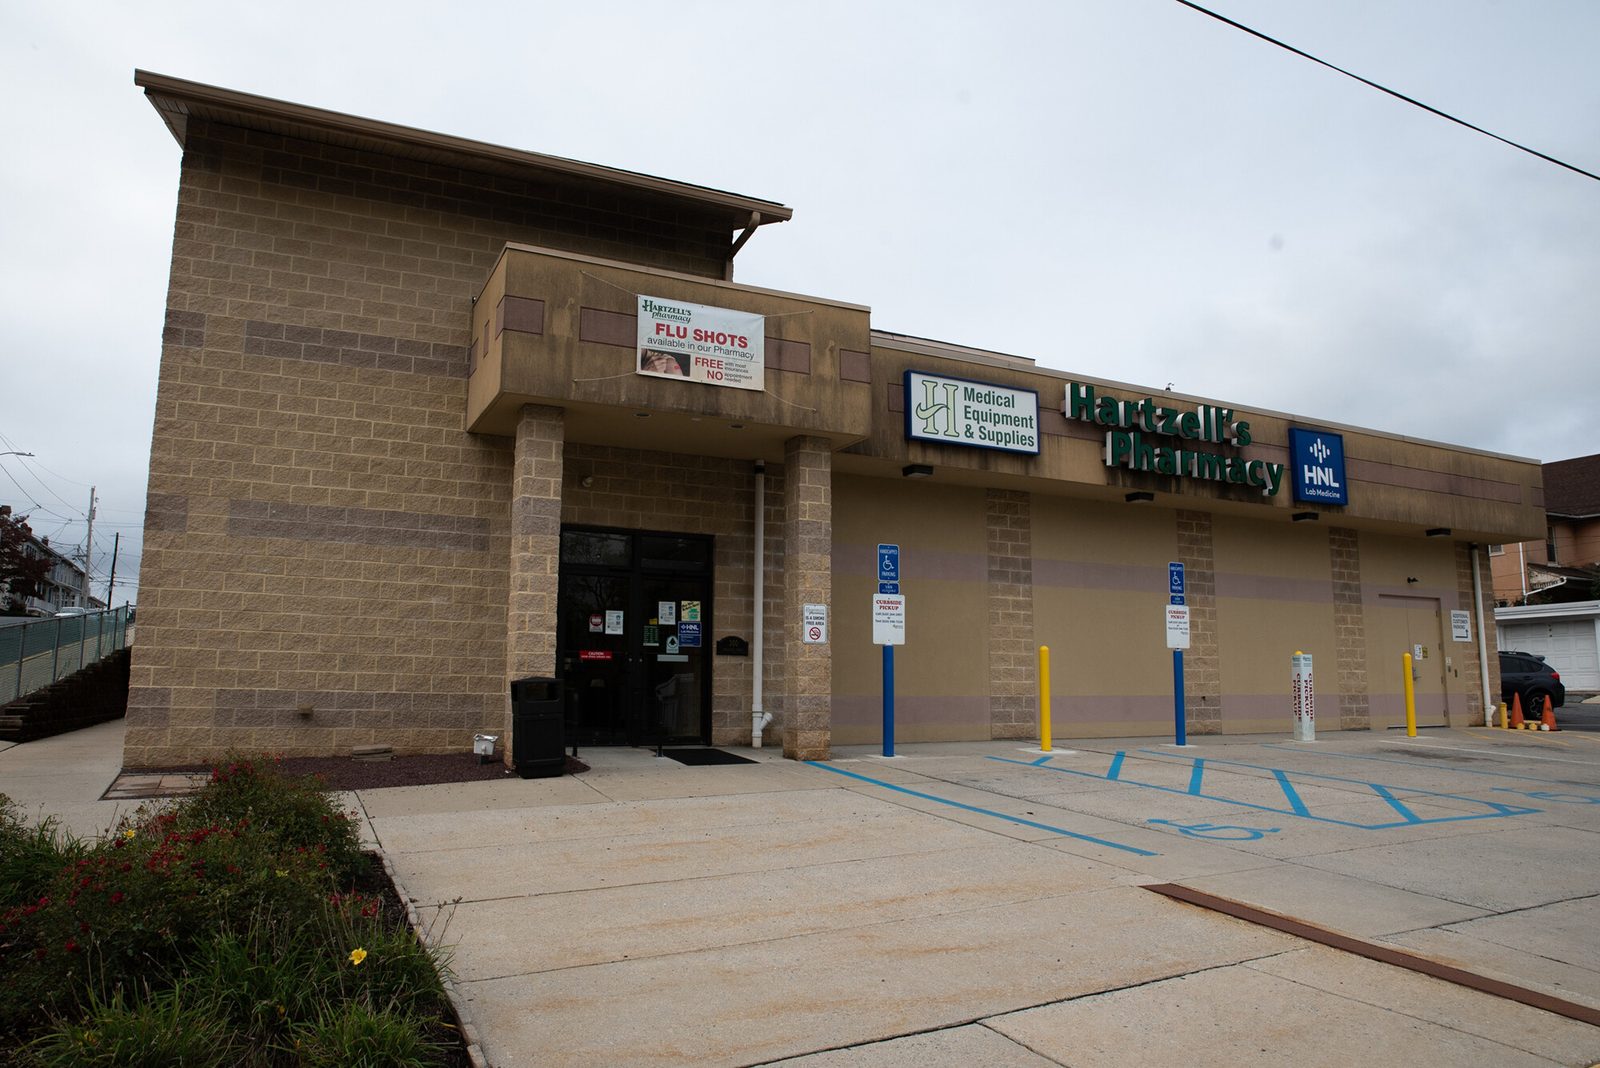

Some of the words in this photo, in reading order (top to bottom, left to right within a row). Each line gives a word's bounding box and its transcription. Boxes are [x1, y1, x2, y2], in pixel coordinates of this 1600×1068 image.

[651, 311, 691, 323] pharmacy
[655, 323, 687, 339] FLU
[693, 329, 748, 348] SHOTS
[647, 337, 685, 349] available
[688, 342, 695, 350] in
[714, 346, 755, 360] Pharmacy
[695, 357, 723, 369] FREE
[707, 370, 723, 380] NO
[964, 386, 1015, 408] Medical
[964, 405, 1034, 429] Equipment
[1065, 382, 1252, 447] Hartzell's
[965, 424, 974, 439] &
[979, 426, 1034, 447] Supplies
[1105, 431, 1284, 496] Pharmacy
[1304, 465, 1340, 488] HNL
[1305, 488, 1316, 496] Lab
[1317, 489, 1340, 498] Medicine
